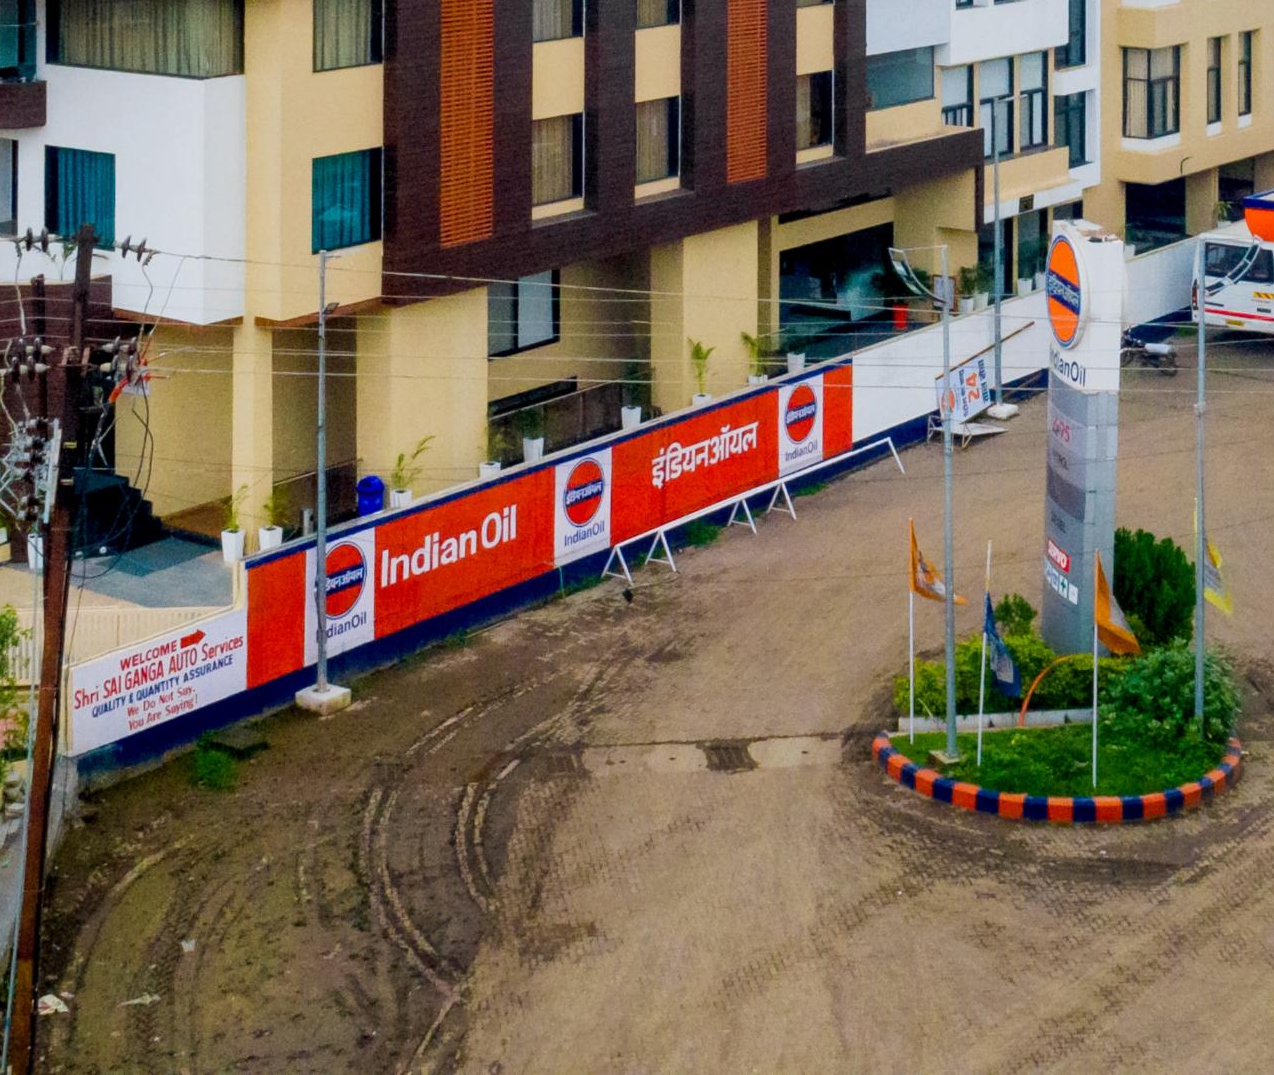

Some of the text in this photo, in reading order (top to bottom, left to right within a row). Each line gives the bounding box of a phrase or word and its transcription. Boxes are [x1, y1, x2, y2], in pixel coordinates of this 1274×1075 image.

[785, 439, 818, 462] IndianOil
[381, 505, 517, 588] IndianOil
[564, 520, 605, 546] IndianOil
[325, 611, 367, 639] dianOil
[120, 640, 178, 671] WELCOME
[74, 635, 244, 710] Shri SAI GANGA AUTO Services
[92, 695, 126, 718] QUALITY
[136, 677, 180, 701] QUANTITY
[183, 654, 234, 682] ASSURANCE
[127, 706, 140, 717] We
[143, 699, 156, 712] Do
[159, 693, 174, 704] Not
[128, 720, 144, 731] You
[147, 712, 162, 724] Are
